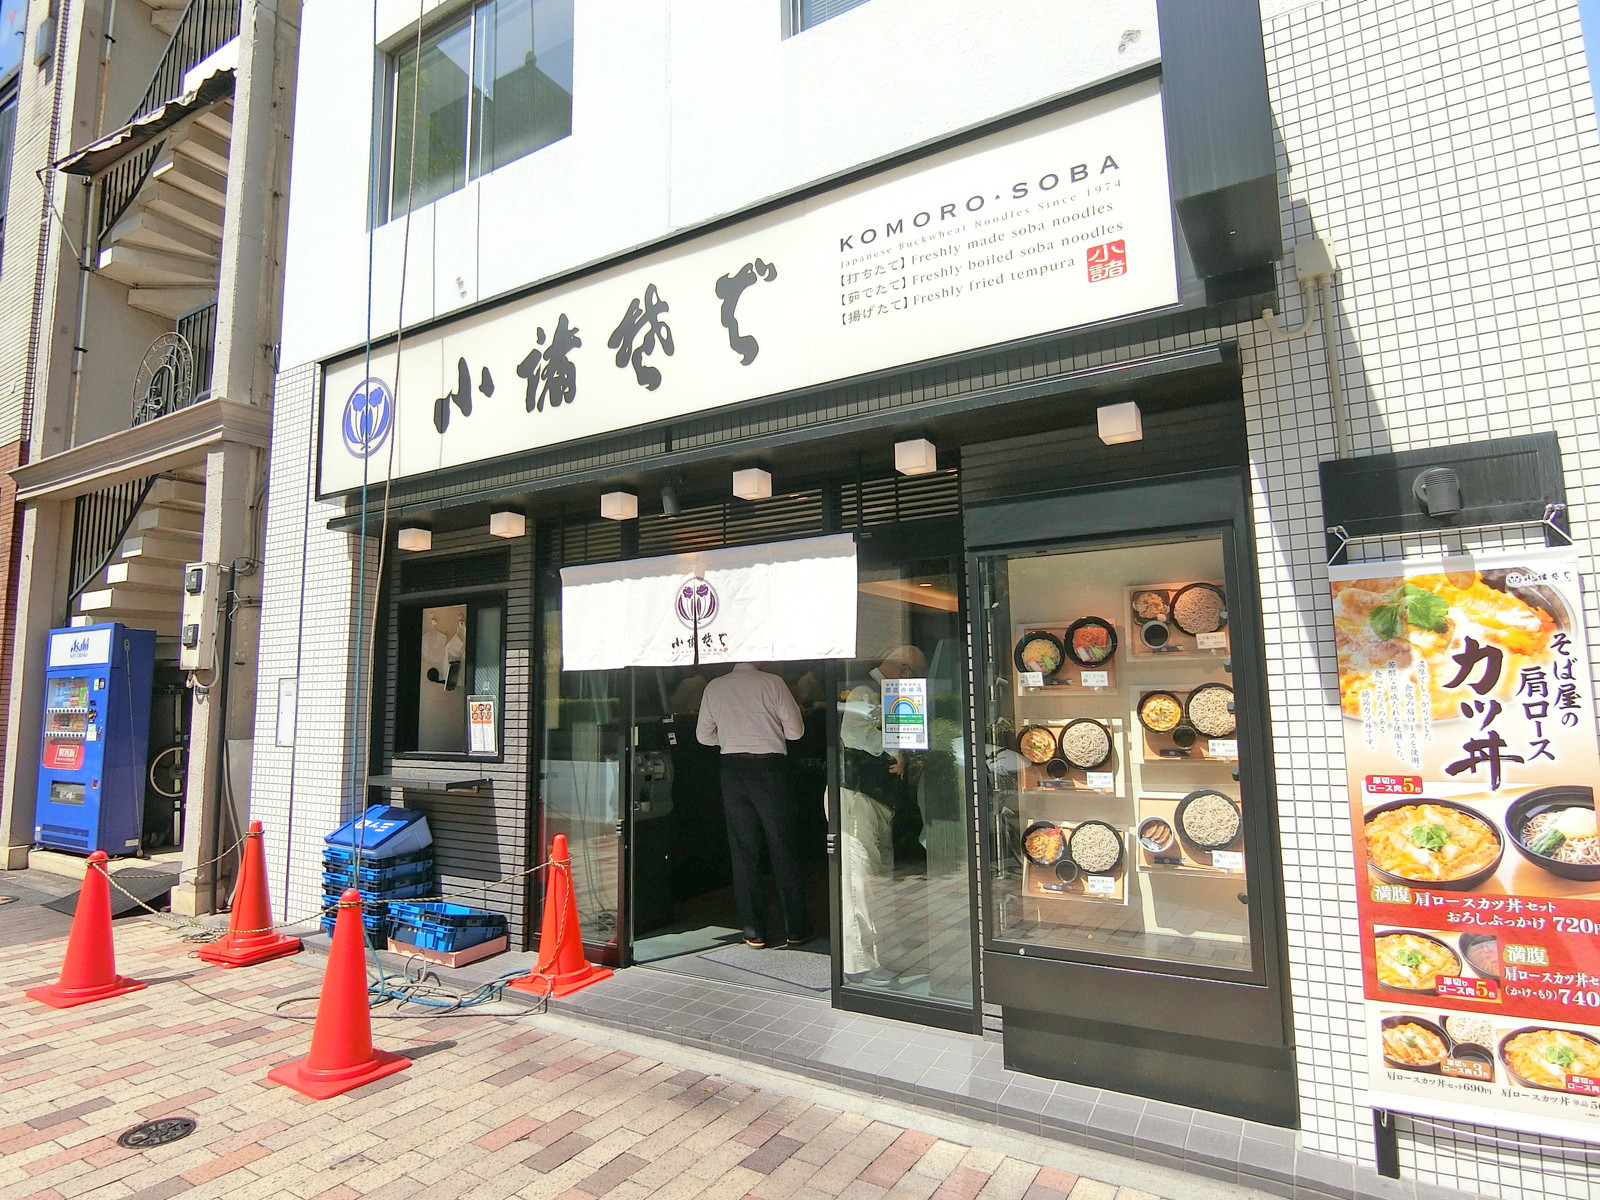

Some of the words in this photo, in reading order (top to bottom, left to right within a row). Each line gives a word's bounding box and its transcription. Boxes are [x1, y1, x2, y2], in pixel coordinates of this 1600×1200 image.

[840, 247, 892, 270] Japanese
[899, 225, 967, 251] Buckwheat
[974, 209, 1030, 228] Noodles
[1037, 194, 1077, 212] Since
[1086, 179, 1121, 197] 1974
[912, 243, 961, 265] Freshly
[967, 232, 1005, 250] made
[1011, 222, 1045, 238] soba
[1052, 202, 1113, 227] noodles
[913, 263, 962, 285] Freshly
[968, 249, 1014, 271] boiled
[1020, 241, 1054, 257] soba
[1061, 222, 1123, 247] noodles
[914, 284, 963, 305] Freshly
[969, 273, 1004, 291] fried
[1011, 257, 1075, 281] tempura
[1550, 632, 1582, 728] そば屋の
[1442, 635, 1525, 791] カツ丼
[1515, 665, 1556, 761] 肩ロース
[1374, 885, 1411, 903] 満腹
[1446, 911, 1546, 930] おろしぶっかけ
[1507, 945, 1548, 965] 満腹
[1590, 1100, 1600, 1110] 5
